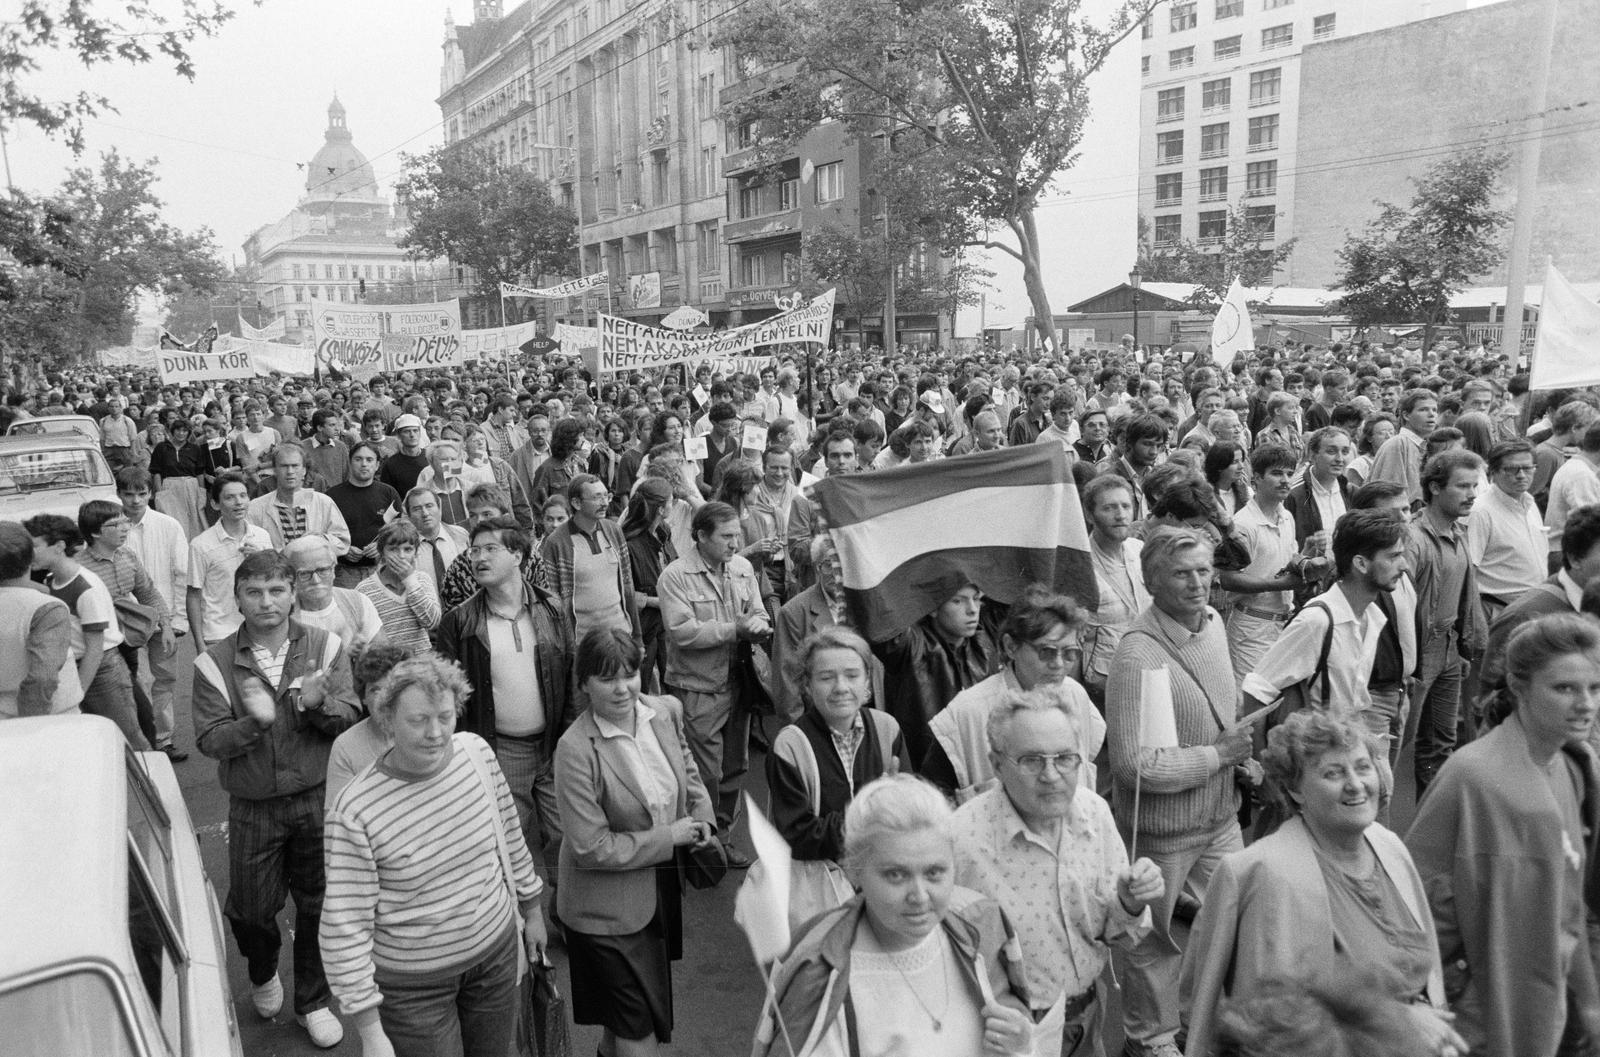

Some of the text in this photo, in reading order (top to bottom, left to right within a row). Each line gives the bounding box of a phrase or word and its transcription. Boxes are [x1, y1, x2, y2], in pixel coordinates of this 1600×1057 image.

[602, 317, 638, 337] NEM
[533, 341, 550, 350] HELP
[602, 335, 638, 353] NEM
[602, 352, 638, 369] NEM
[753, 322, 823, 344] LENYELNI
[163, 352, 250, 374] DUNA KÖR
